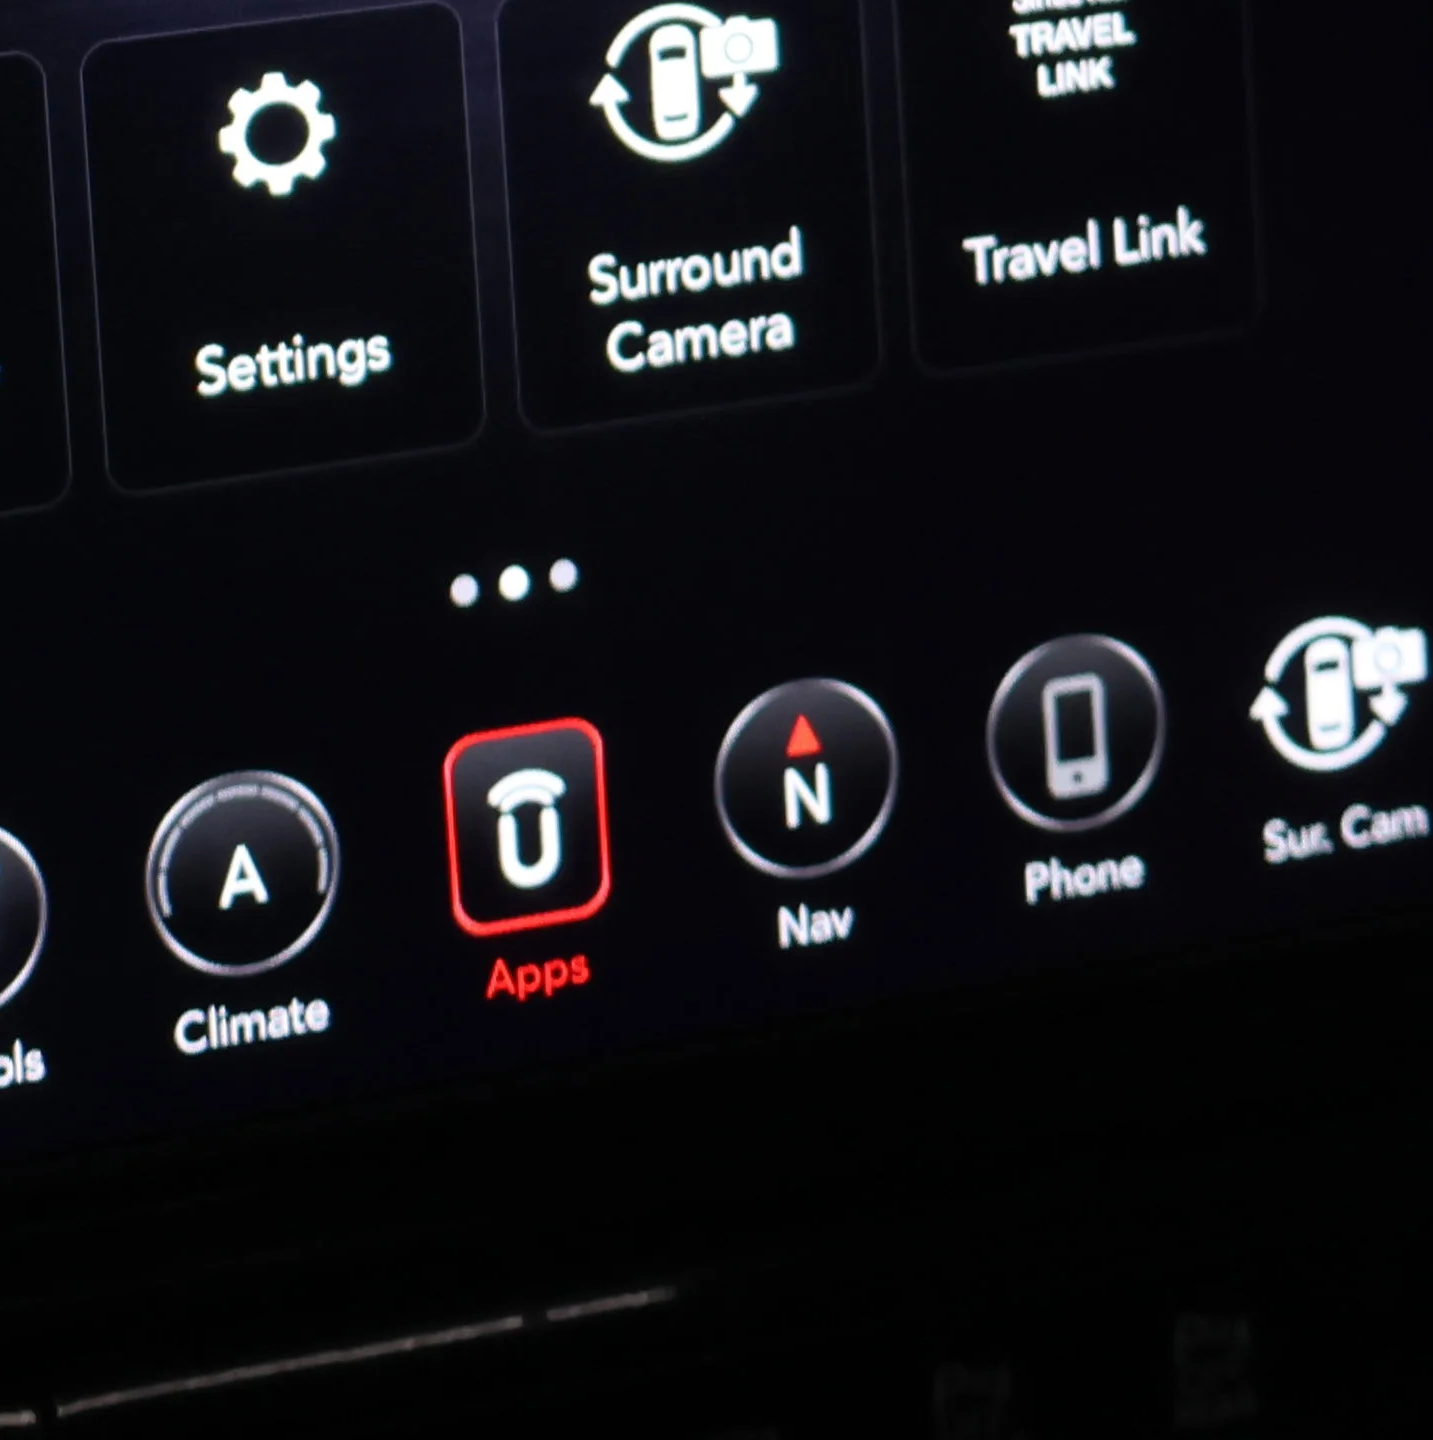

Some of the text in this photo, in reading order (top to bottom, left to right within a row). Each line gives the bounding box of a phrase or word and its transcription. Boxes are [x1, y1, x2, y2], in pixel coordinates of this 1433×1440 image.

[1008, 10, 1138, 60] TRAVEL
[1036, 54, 1117, 99] LINK
[587, 225, 804, 306] Surround
[962, 205, 1207, 285] Travel Link
[194, 333, 393, 397] Settings
[606, 312, 795, 373] Camera
[783, 760, 832, 830] N
[1262, 803, 1430, 864] Sur. Cam
[219, 843, 269, 910] A
[1024, 855, 1146, 904] Phone
[777, 903, 854, 948] Nav
[485, 954, 591, 1002] Apps
[174, 997, 331, 1055] Climate
